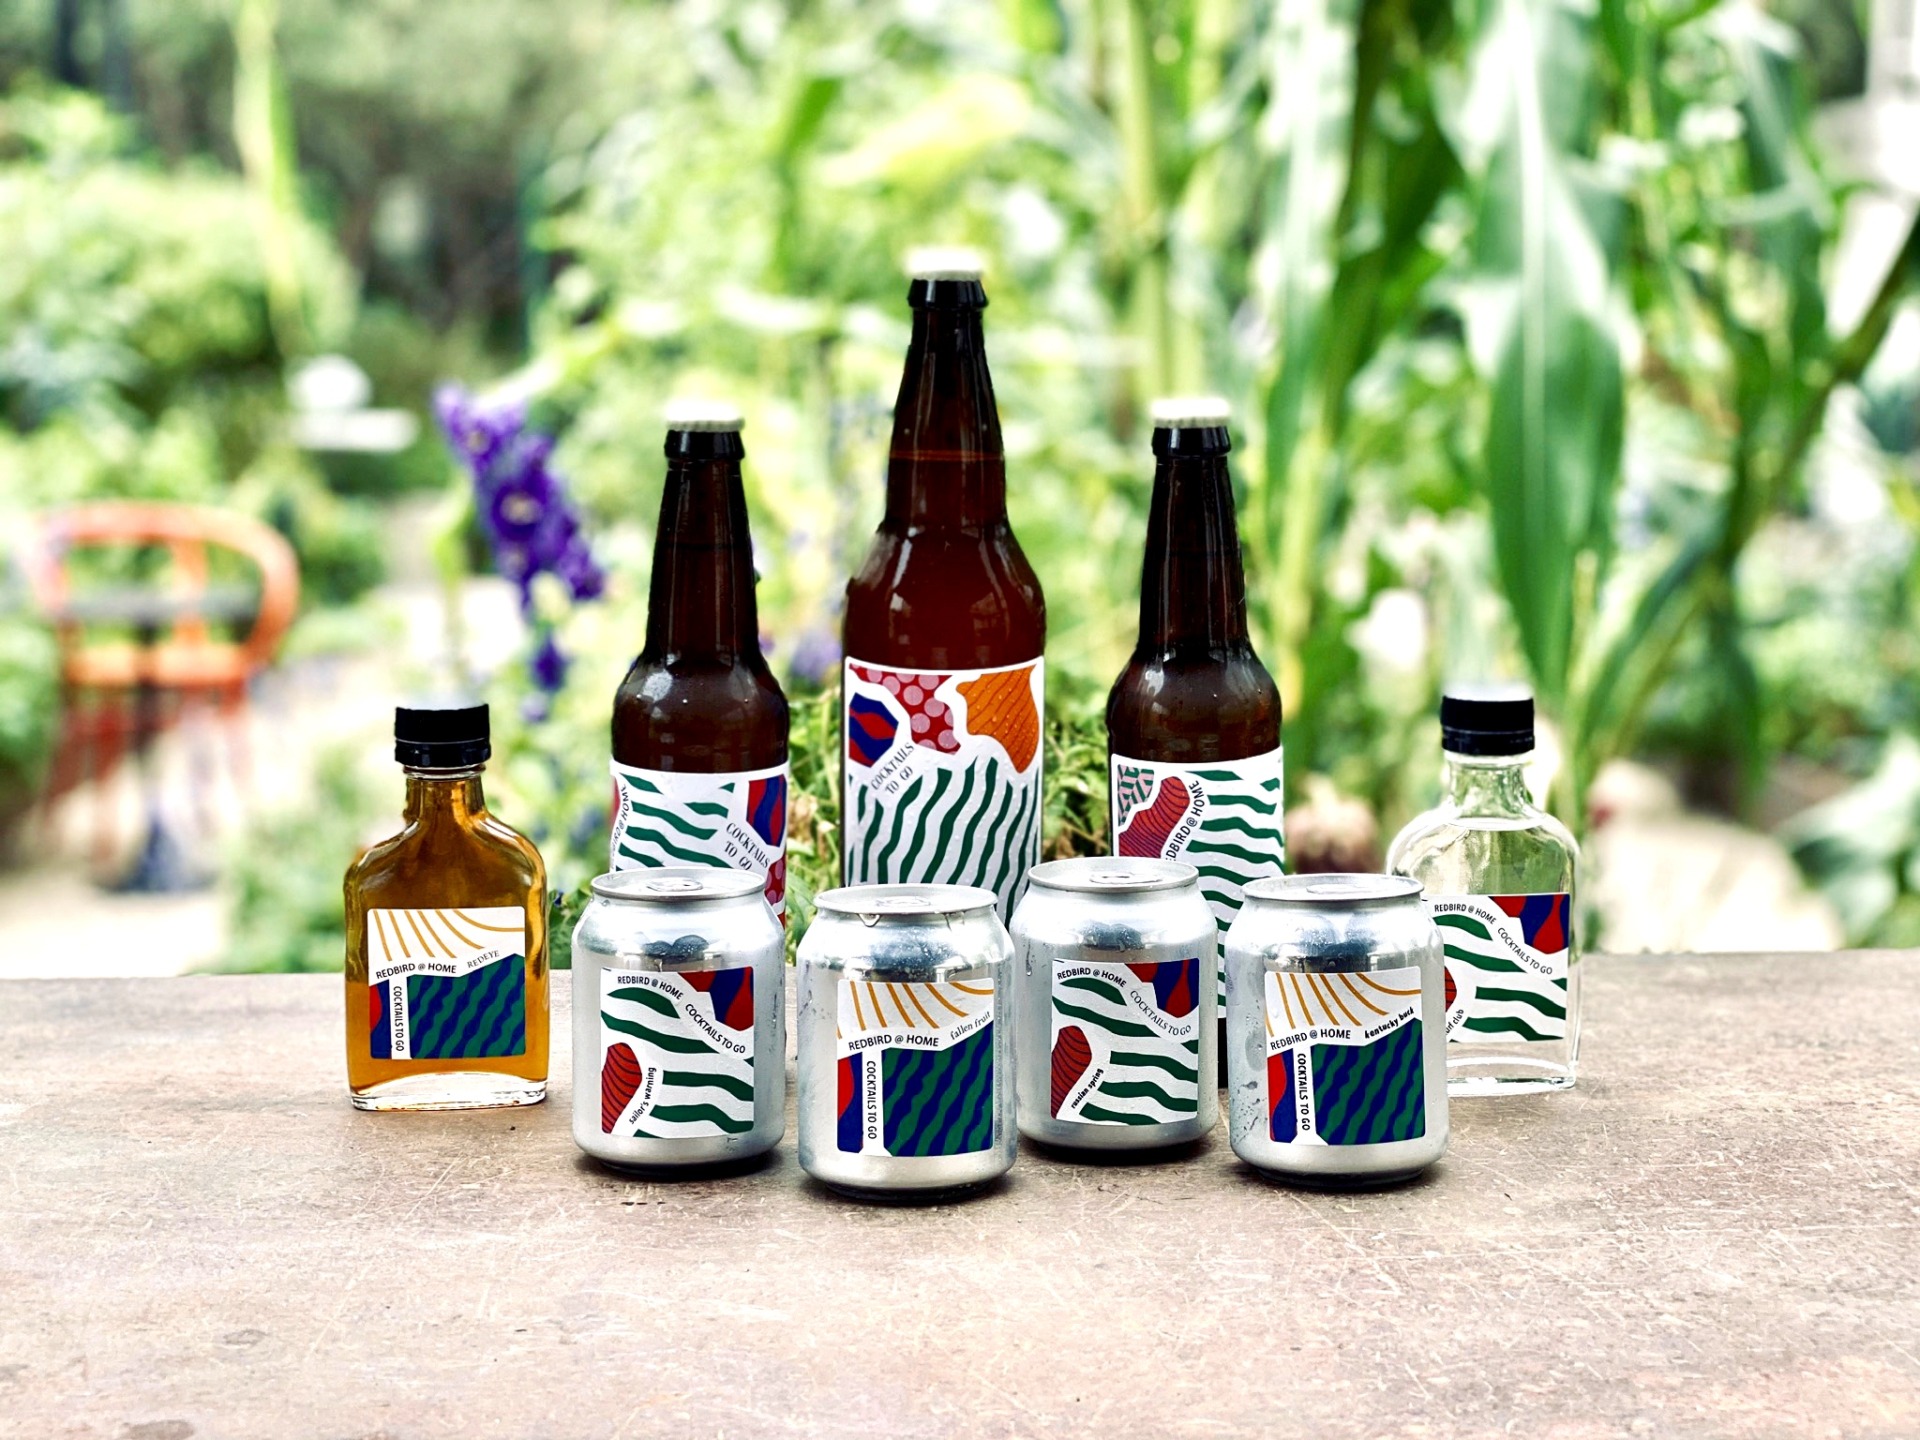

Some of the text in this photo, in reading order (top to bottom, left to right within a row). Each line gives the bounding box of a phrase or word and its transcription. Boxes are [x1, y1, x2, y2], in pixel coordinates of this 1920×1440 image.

[870, 742, 915, 790] COCKTAILS
[885, 766, 913, 795] TO GO
[1165, 780, 1205, 861] DBIRD @ HOME
[723, 841, 752, 870] TO GO
[725, 822, 770, 869] COCKTAILS
[1434, 903, 1497, 925] REDBIRD @ HOME
[467, 950, 500, 969] REDEYE
[1497, 927, 1553, 975] COCKTAILS TO GO
[376, 963, 457, 979] REDBIRD @ HOME
[617, 975, 684, 1000] REDBIRD @ HOME
[1056, 967, 1127, 988] REDBIRD @ HOME
[393, 986, 405, 1052] COCKTAILS TO GO
[685, 1003, 746, 1054] COCKTAILS TO GO
[950, 1011, 991, 1040] fallen fruit
[1130, 990, 1192, 1036] COCKTAILS TO GO
[1364, 1006, 1415, 1039] kentucky buck
[1452, 1008, 1464, 1025] club
[848, 1034, 939, 1051] REDBIRD @ HOME
[1270, 1028, 1351, 1051] REDBIRD @ HOME
[628, 1067, 657, 1125] sailor's warning
[866, 1060, 877, 1140] COCKTAILS TO GO
[1071, 1067, 1104, 1109] russian spring
[1297, 1053, 1310, 1131] COCKTAILS TO GO
